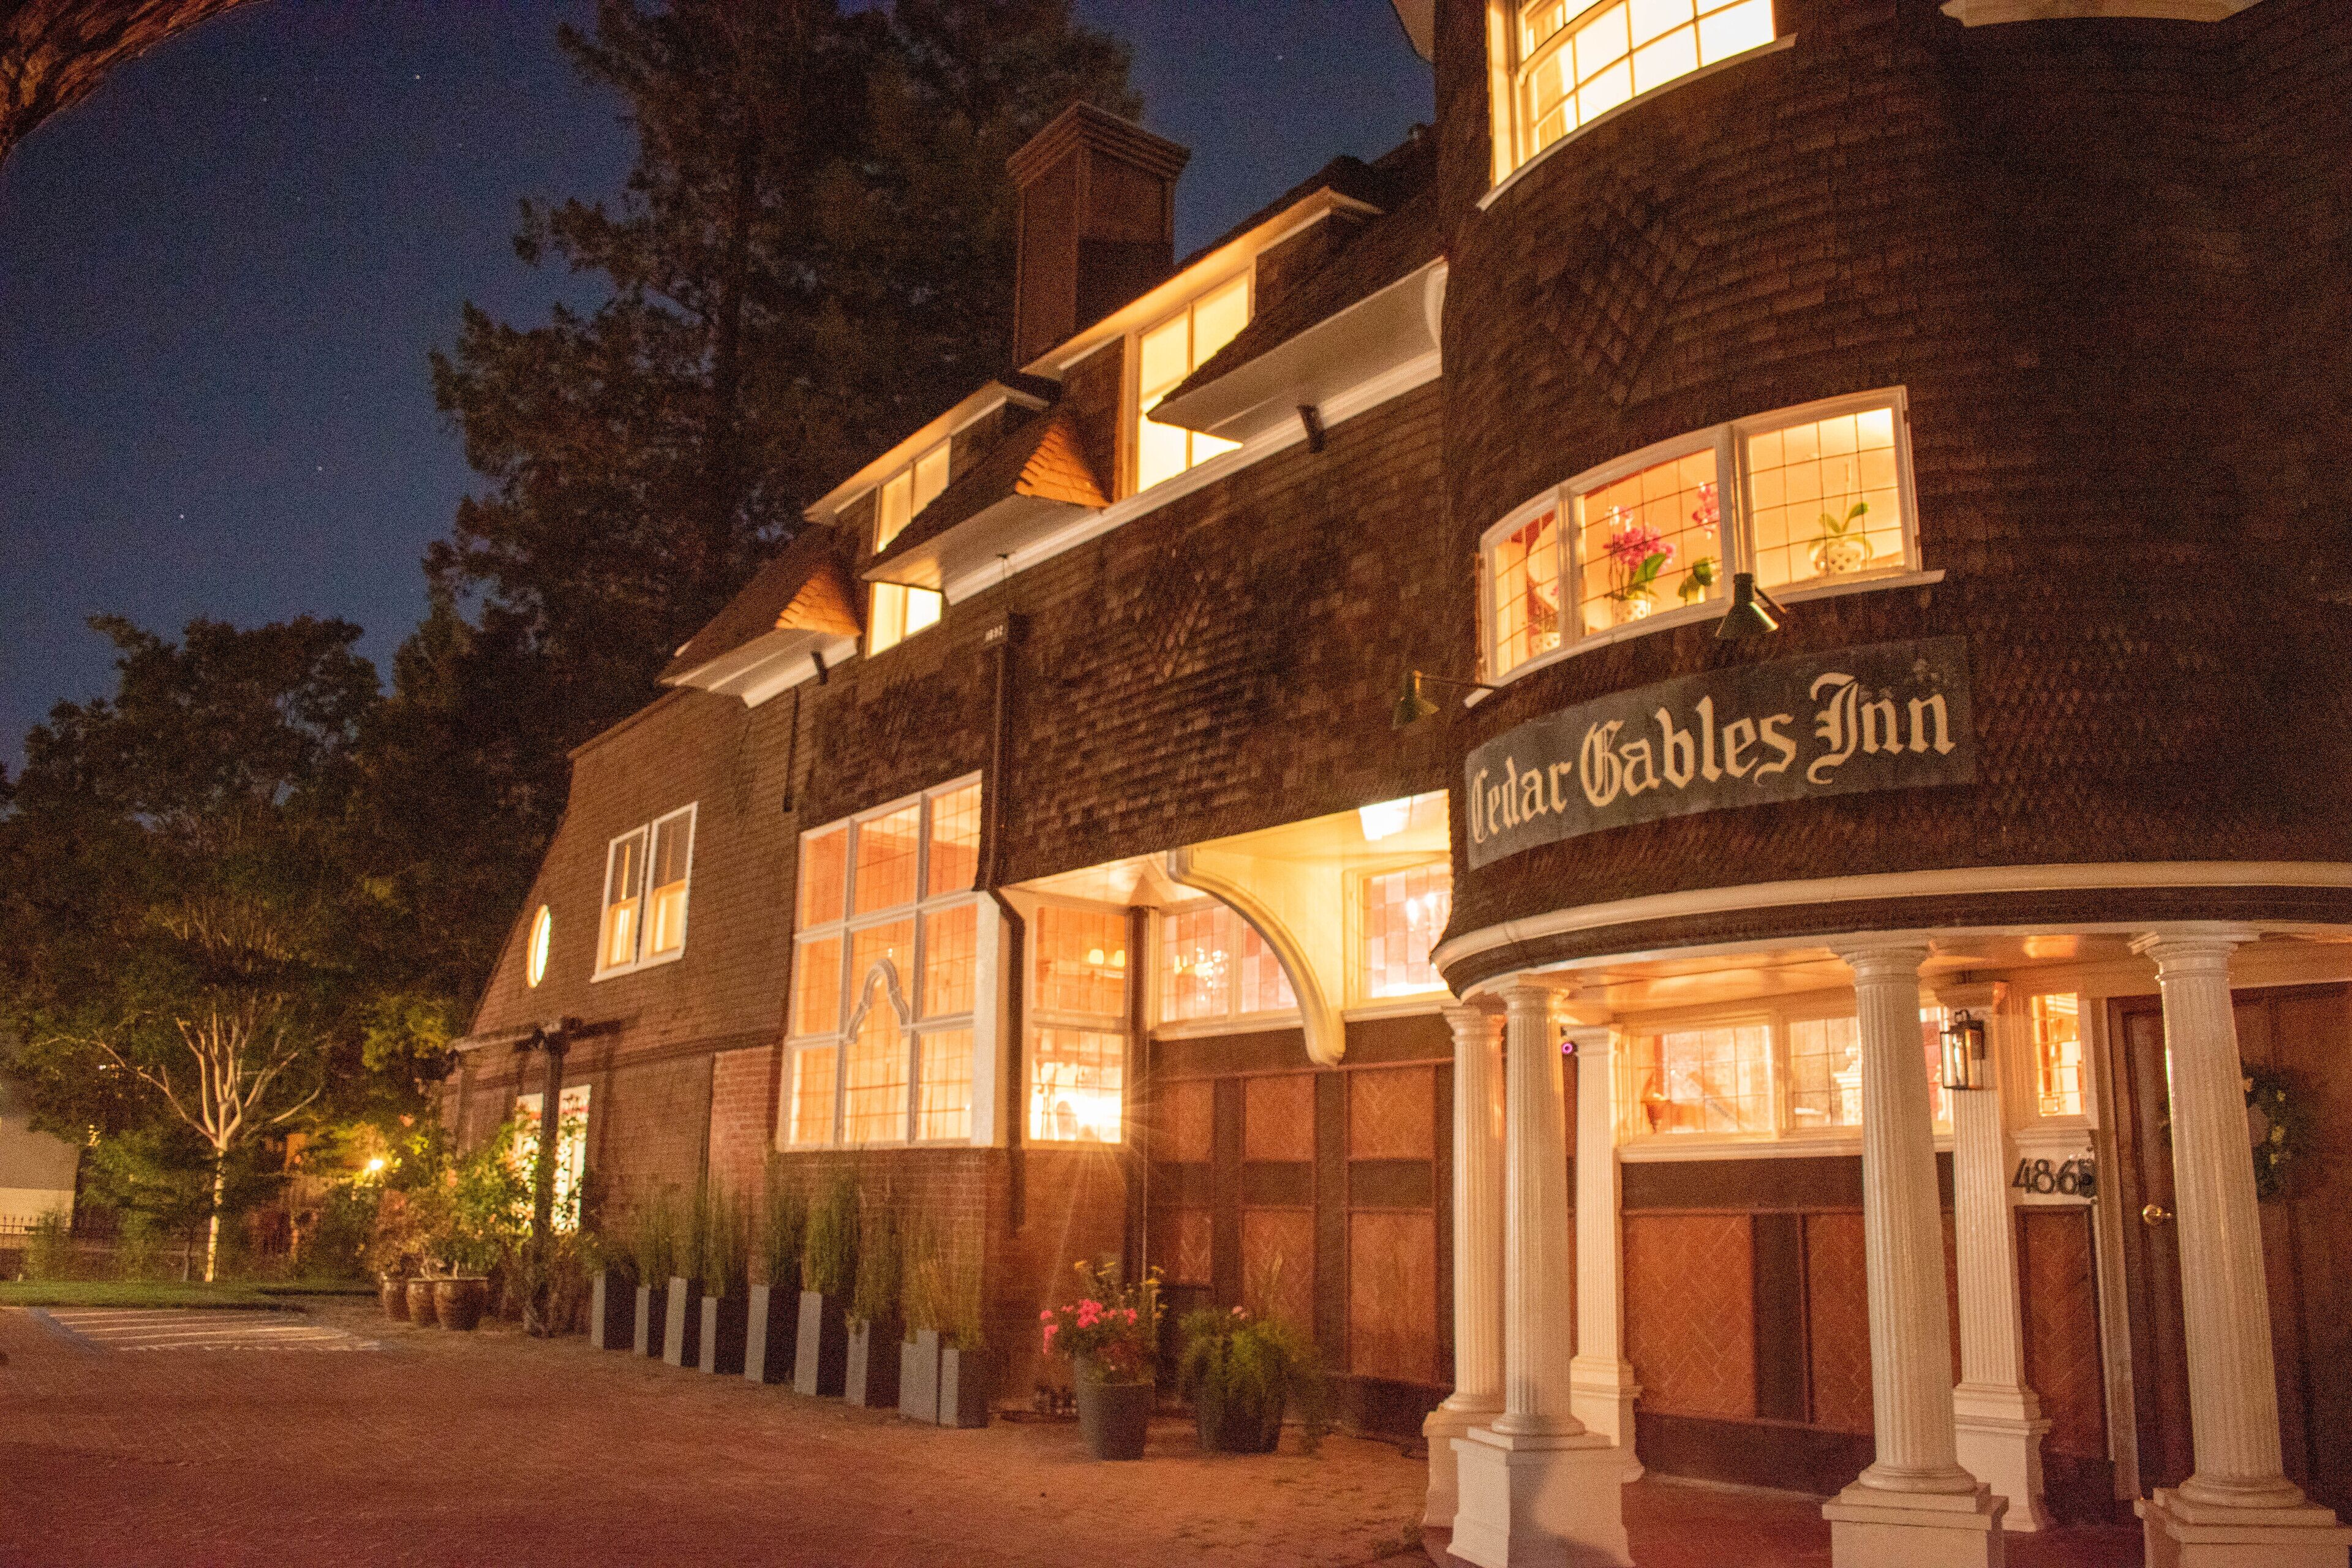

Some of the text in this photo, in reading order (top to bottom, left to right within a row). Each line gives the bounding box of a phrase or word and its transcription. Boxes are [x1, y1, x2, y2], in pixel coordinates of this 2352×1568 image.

[1470, 672, 1956, 843] Cedar Gables Inn
